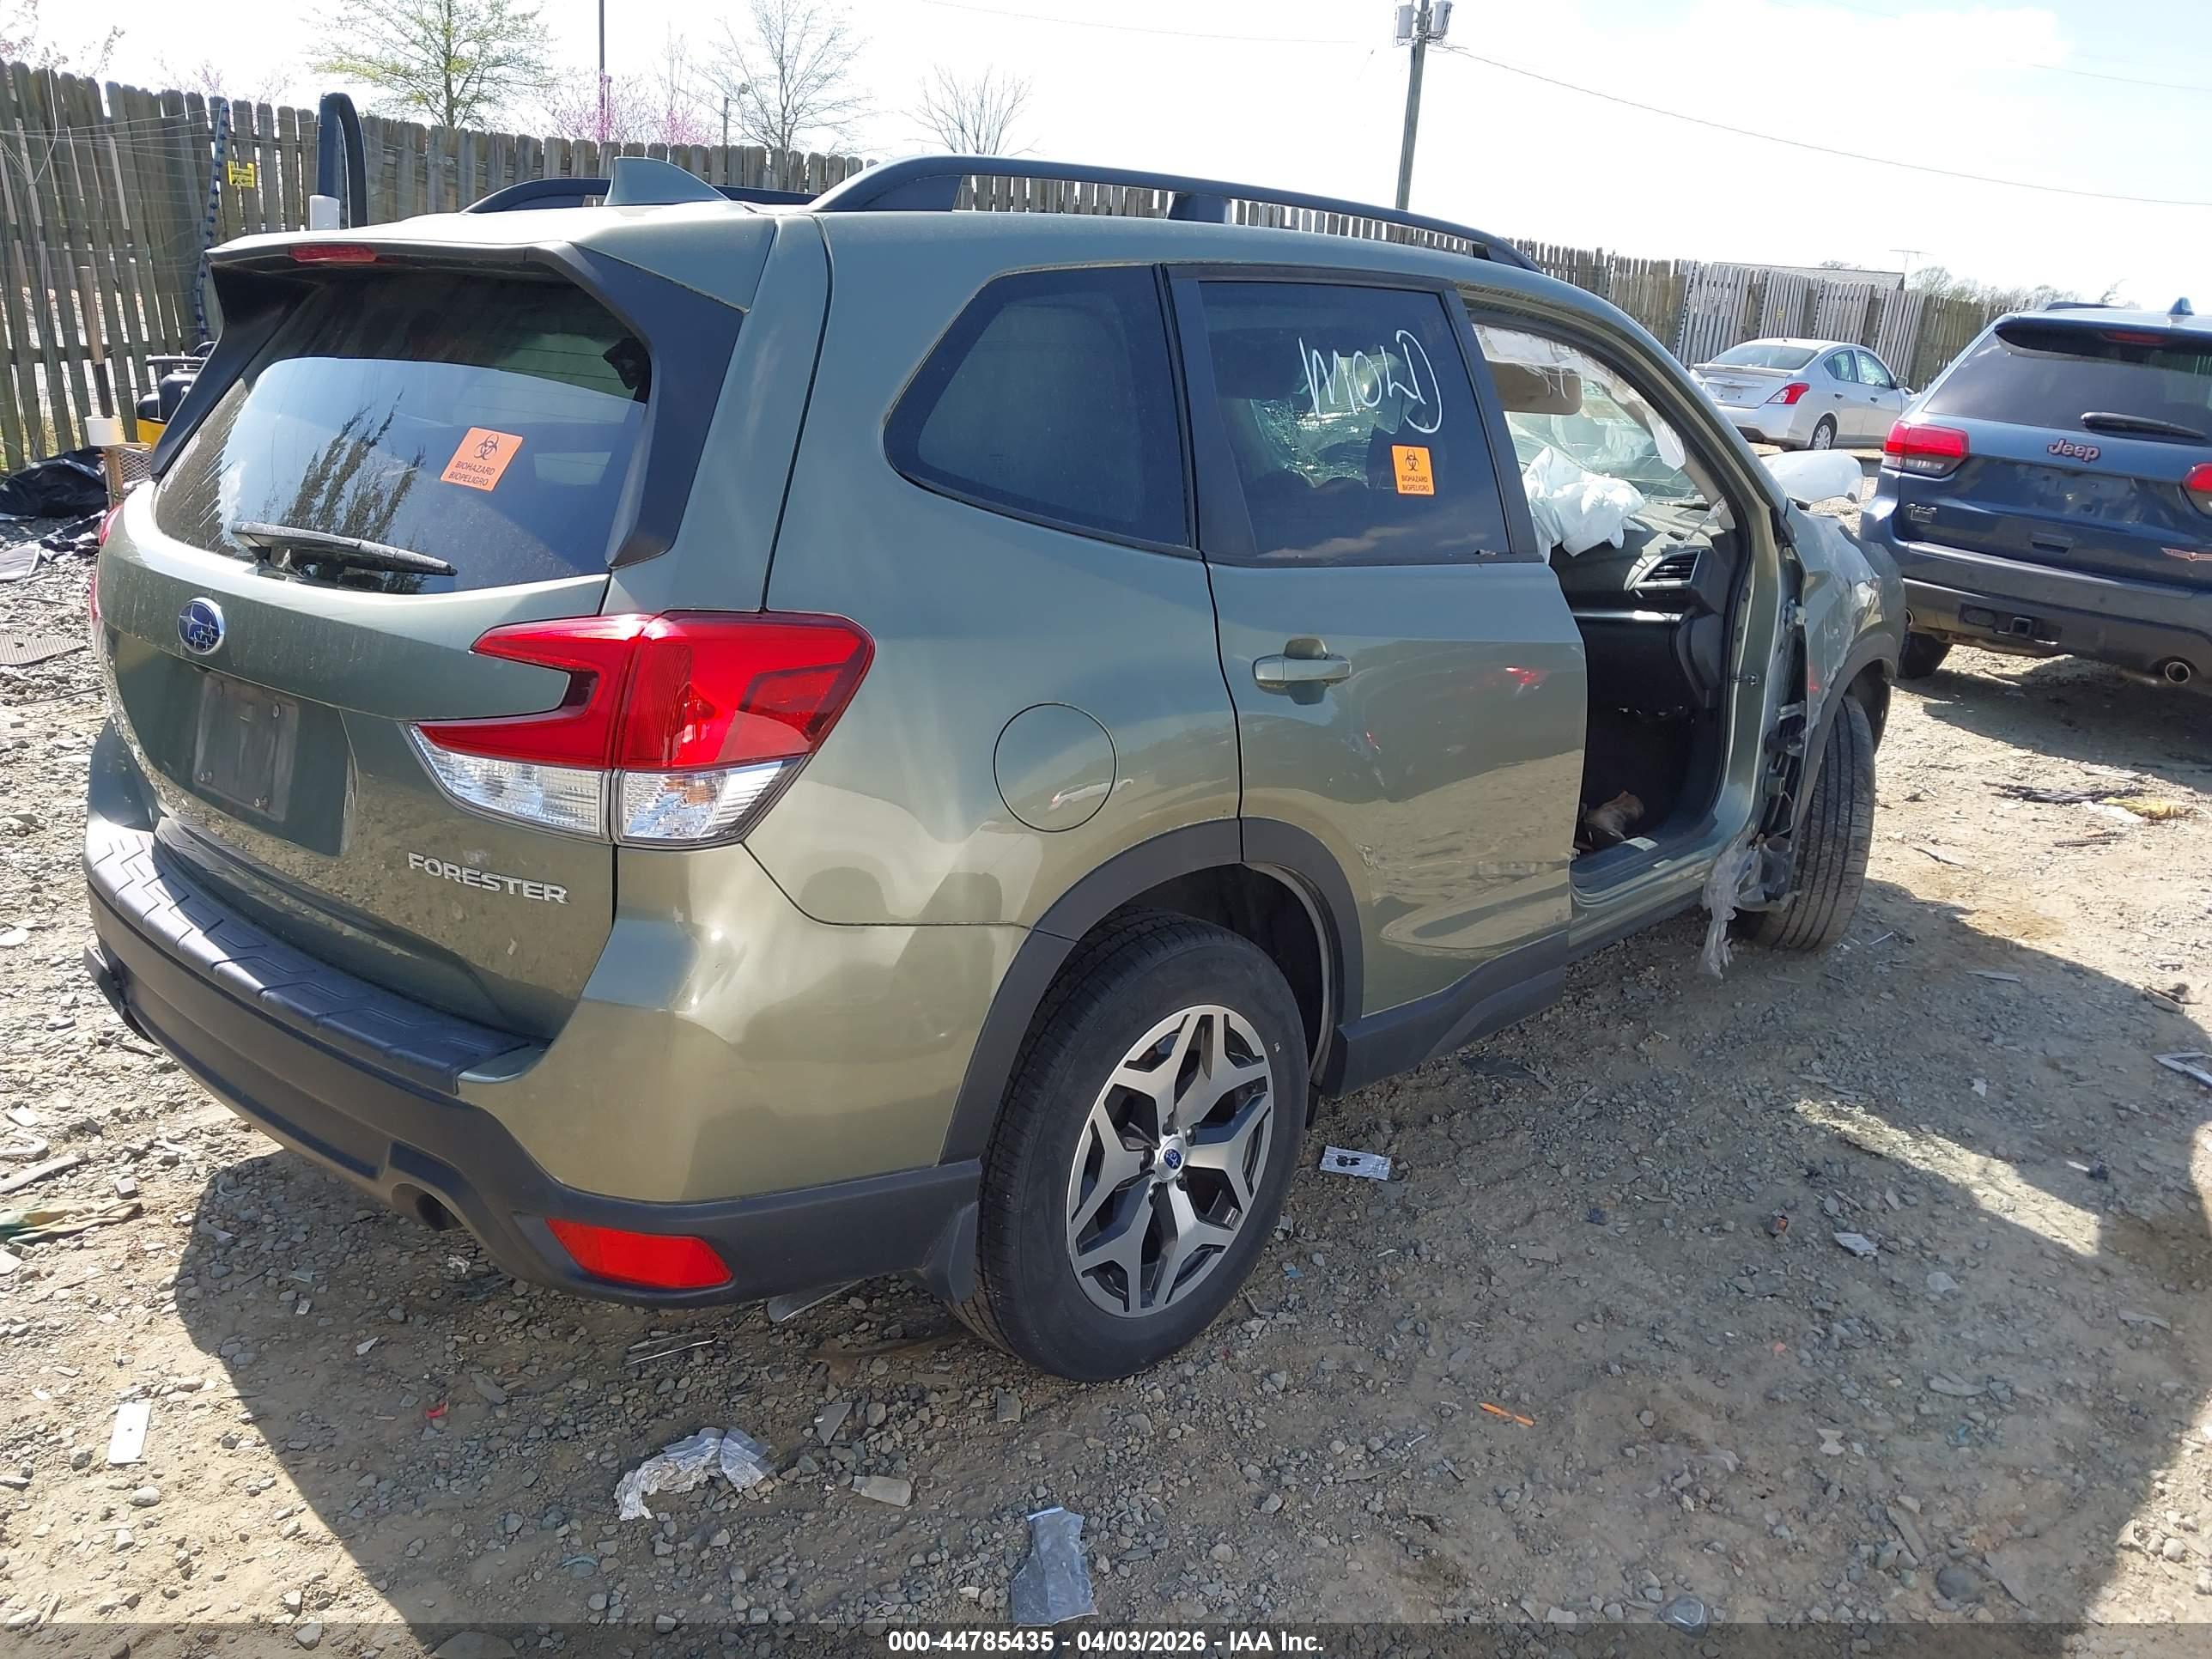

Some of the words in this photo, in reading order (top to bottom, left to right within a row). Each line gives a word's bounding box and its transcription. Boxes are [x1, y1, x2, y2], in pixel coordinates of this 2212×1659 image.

[2048, 439, 2100, 462] Jeep
[455, 460, 495, 476] BIOHAZARD
[448, 471, 489, 486] BIOPELIGRO
[1401, 474, 1429, 483] BIOHAZARD
[407, 851, 570, 904] FORESTER
